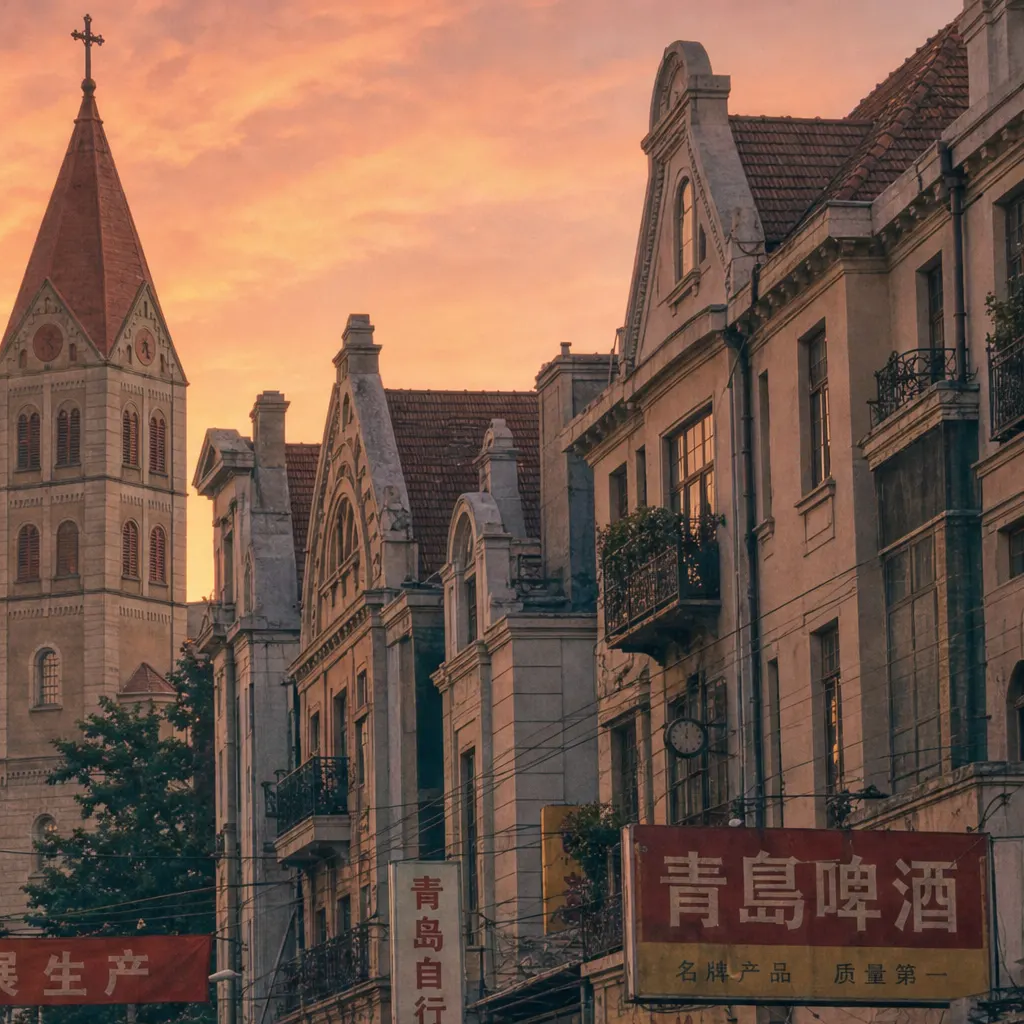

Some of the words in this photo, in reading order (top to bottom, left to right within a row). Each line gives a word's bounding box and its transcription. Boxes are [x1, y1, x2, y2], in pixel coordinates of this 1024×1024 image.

[660, 850, 958, 933] 青島啤酒
[676, 960, 791, 984] 名牌产品
[834, 963, 948, 986] 质量第一
